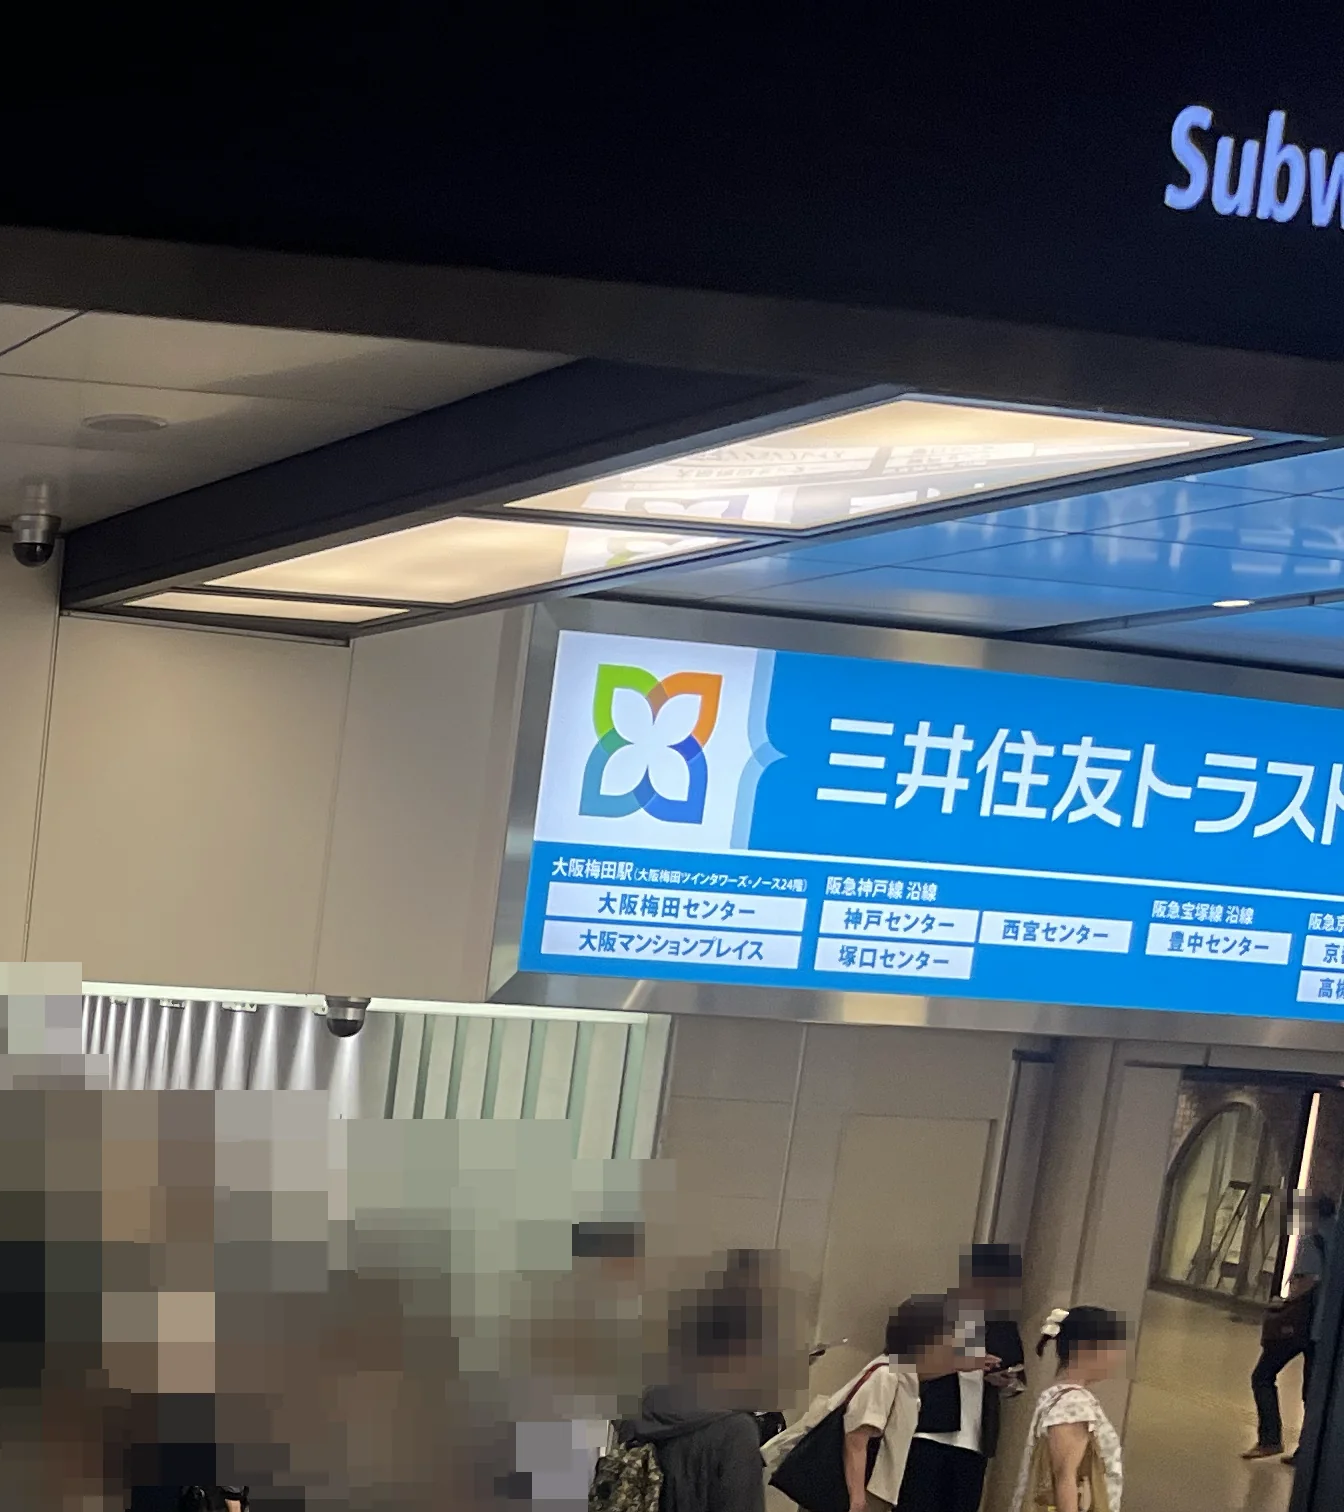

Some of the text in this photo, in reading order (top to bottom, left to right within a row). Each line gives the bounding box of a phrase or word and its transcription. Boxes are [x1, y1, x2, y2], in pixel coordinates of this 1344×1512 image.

[825, 876, 904, 900] 阪急神戸線
[598, 892, 755, 921] 大阪梅田センター
[844, 908, 1108, 944] 神戸センター 西宮センター
[578, 929, 764, 960] 大阪マンションプレイス
[1168, 930, 1269, 956] 豊中センター
[1323, 943, 1344, 963] 京
[838, 945, 949, 970] 塚口センター
